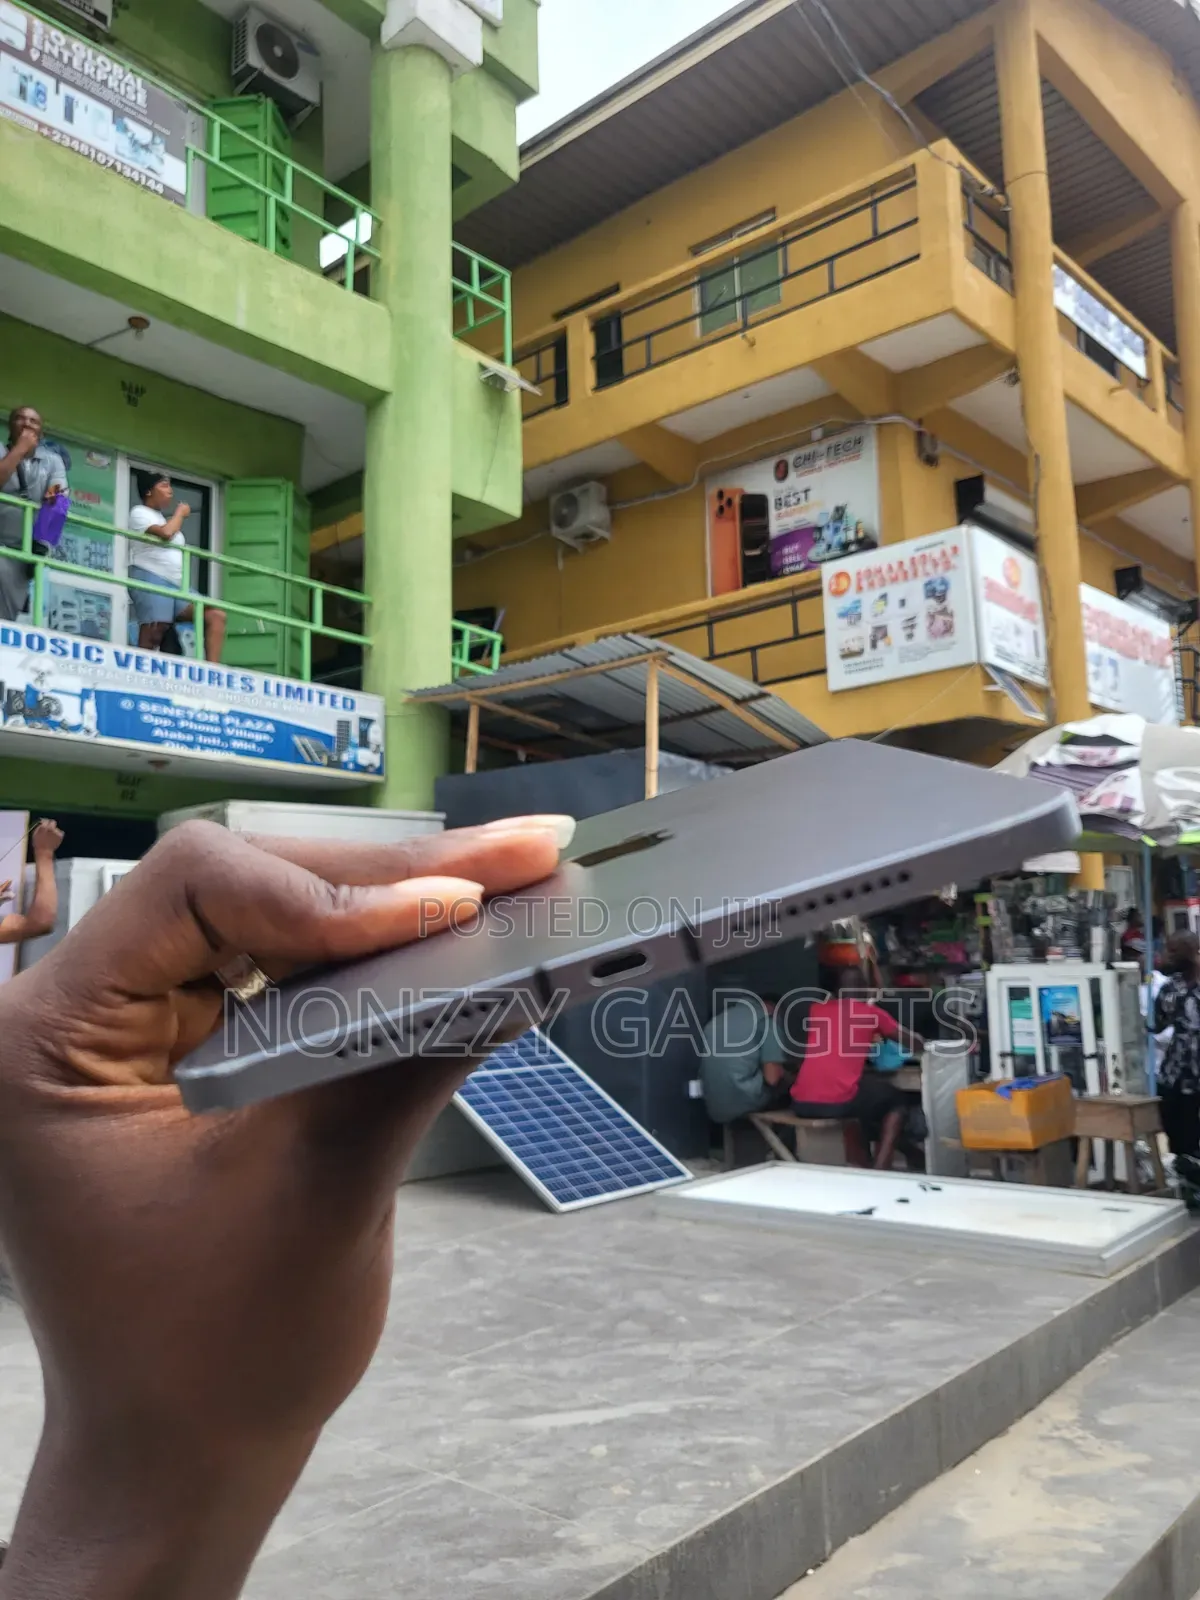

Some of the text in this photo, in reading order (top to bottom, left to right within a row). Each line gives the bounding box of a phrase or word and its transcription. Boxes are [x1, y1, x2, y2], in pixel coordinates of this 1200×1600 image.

[774, 488, 811, 511] BEST
[0, 627, 356, 711] DOSIC VENTURES LIMITED
[222, 714, 276, 733] PLAZA
